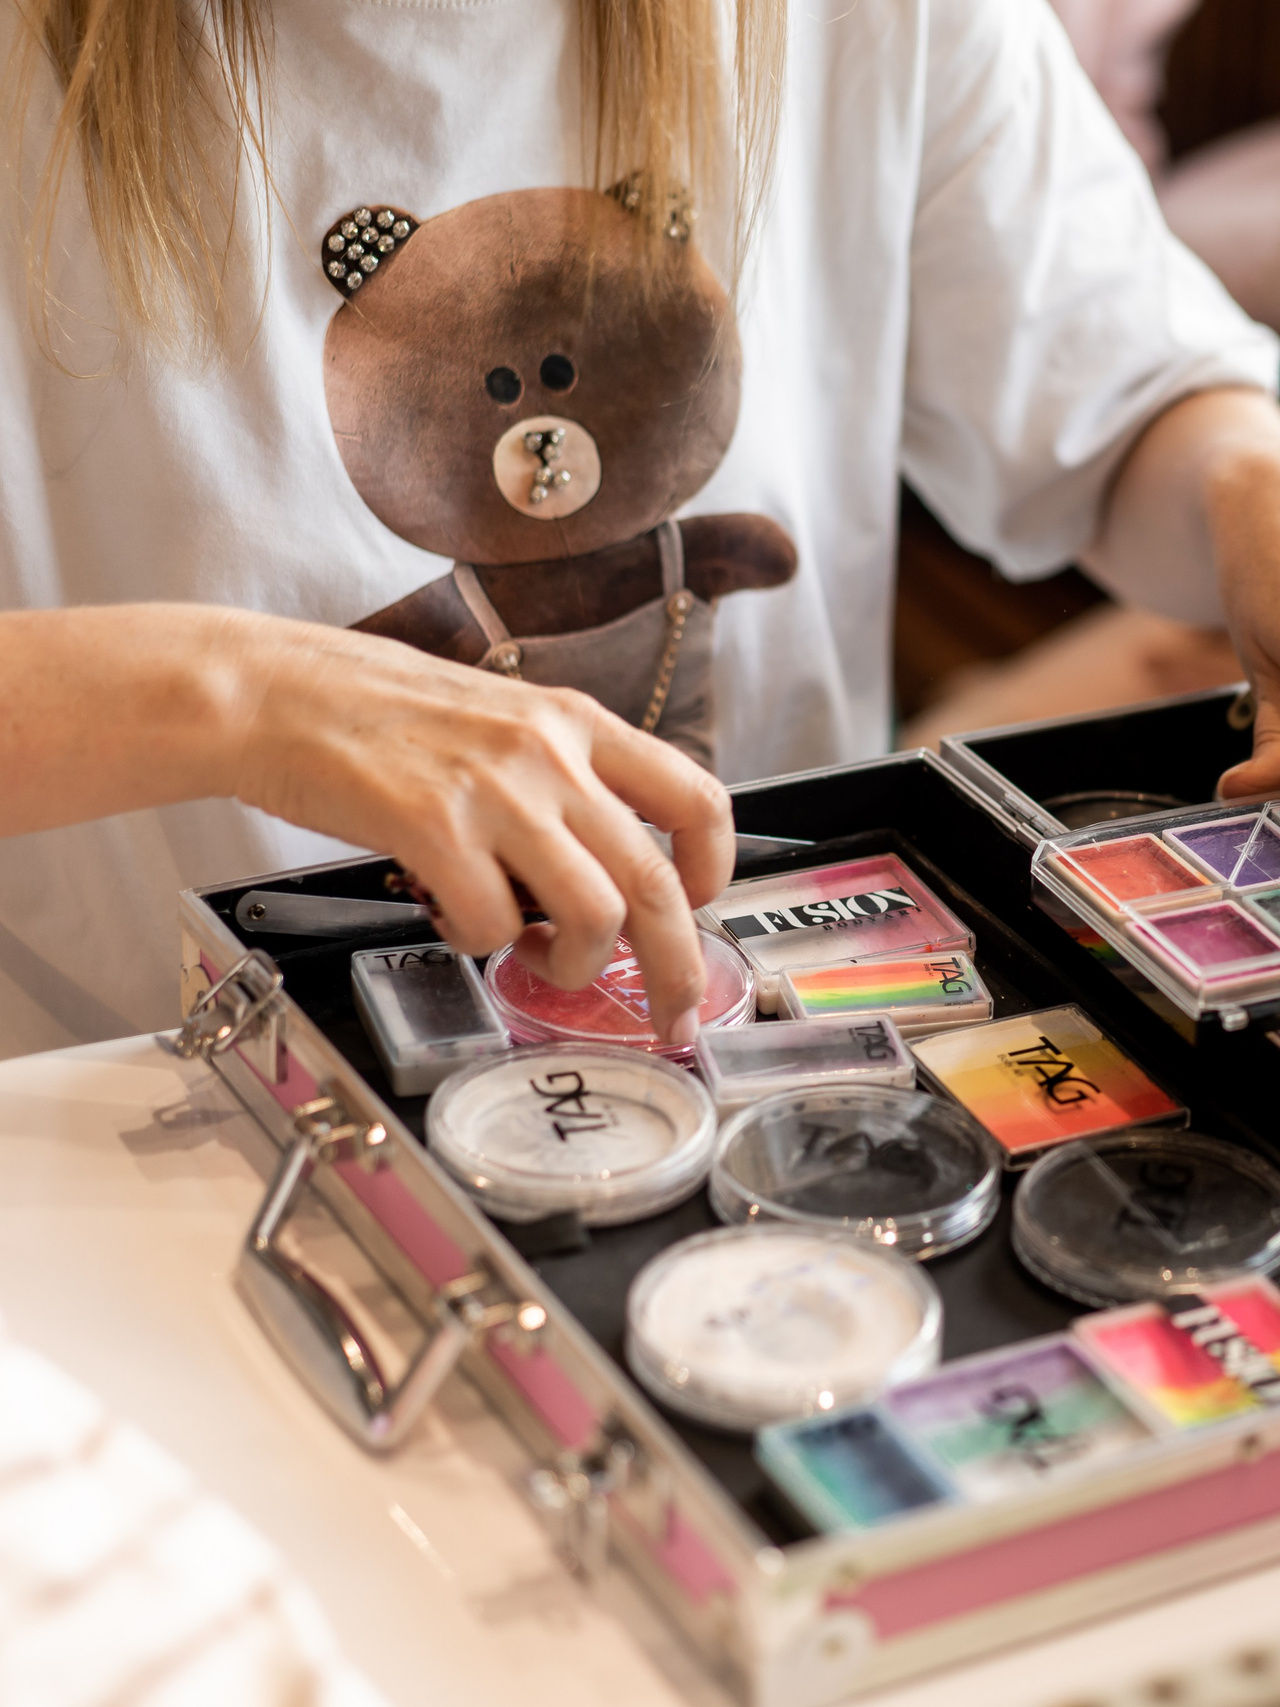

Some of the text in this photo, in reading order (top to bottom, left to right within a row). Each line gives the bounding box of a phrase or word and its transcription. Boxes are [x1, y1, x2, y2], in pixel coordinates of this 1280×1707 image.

[753, 889, 917, 934] FUSION
[374, 948, 453, 969] TAG
[930, 957, 973, 996] TAG
[855, 1021, 896, 1060] TAG
[1008, 1036, 1101, 1105] TAG
[530, 1071, 607, 1142] TAG
